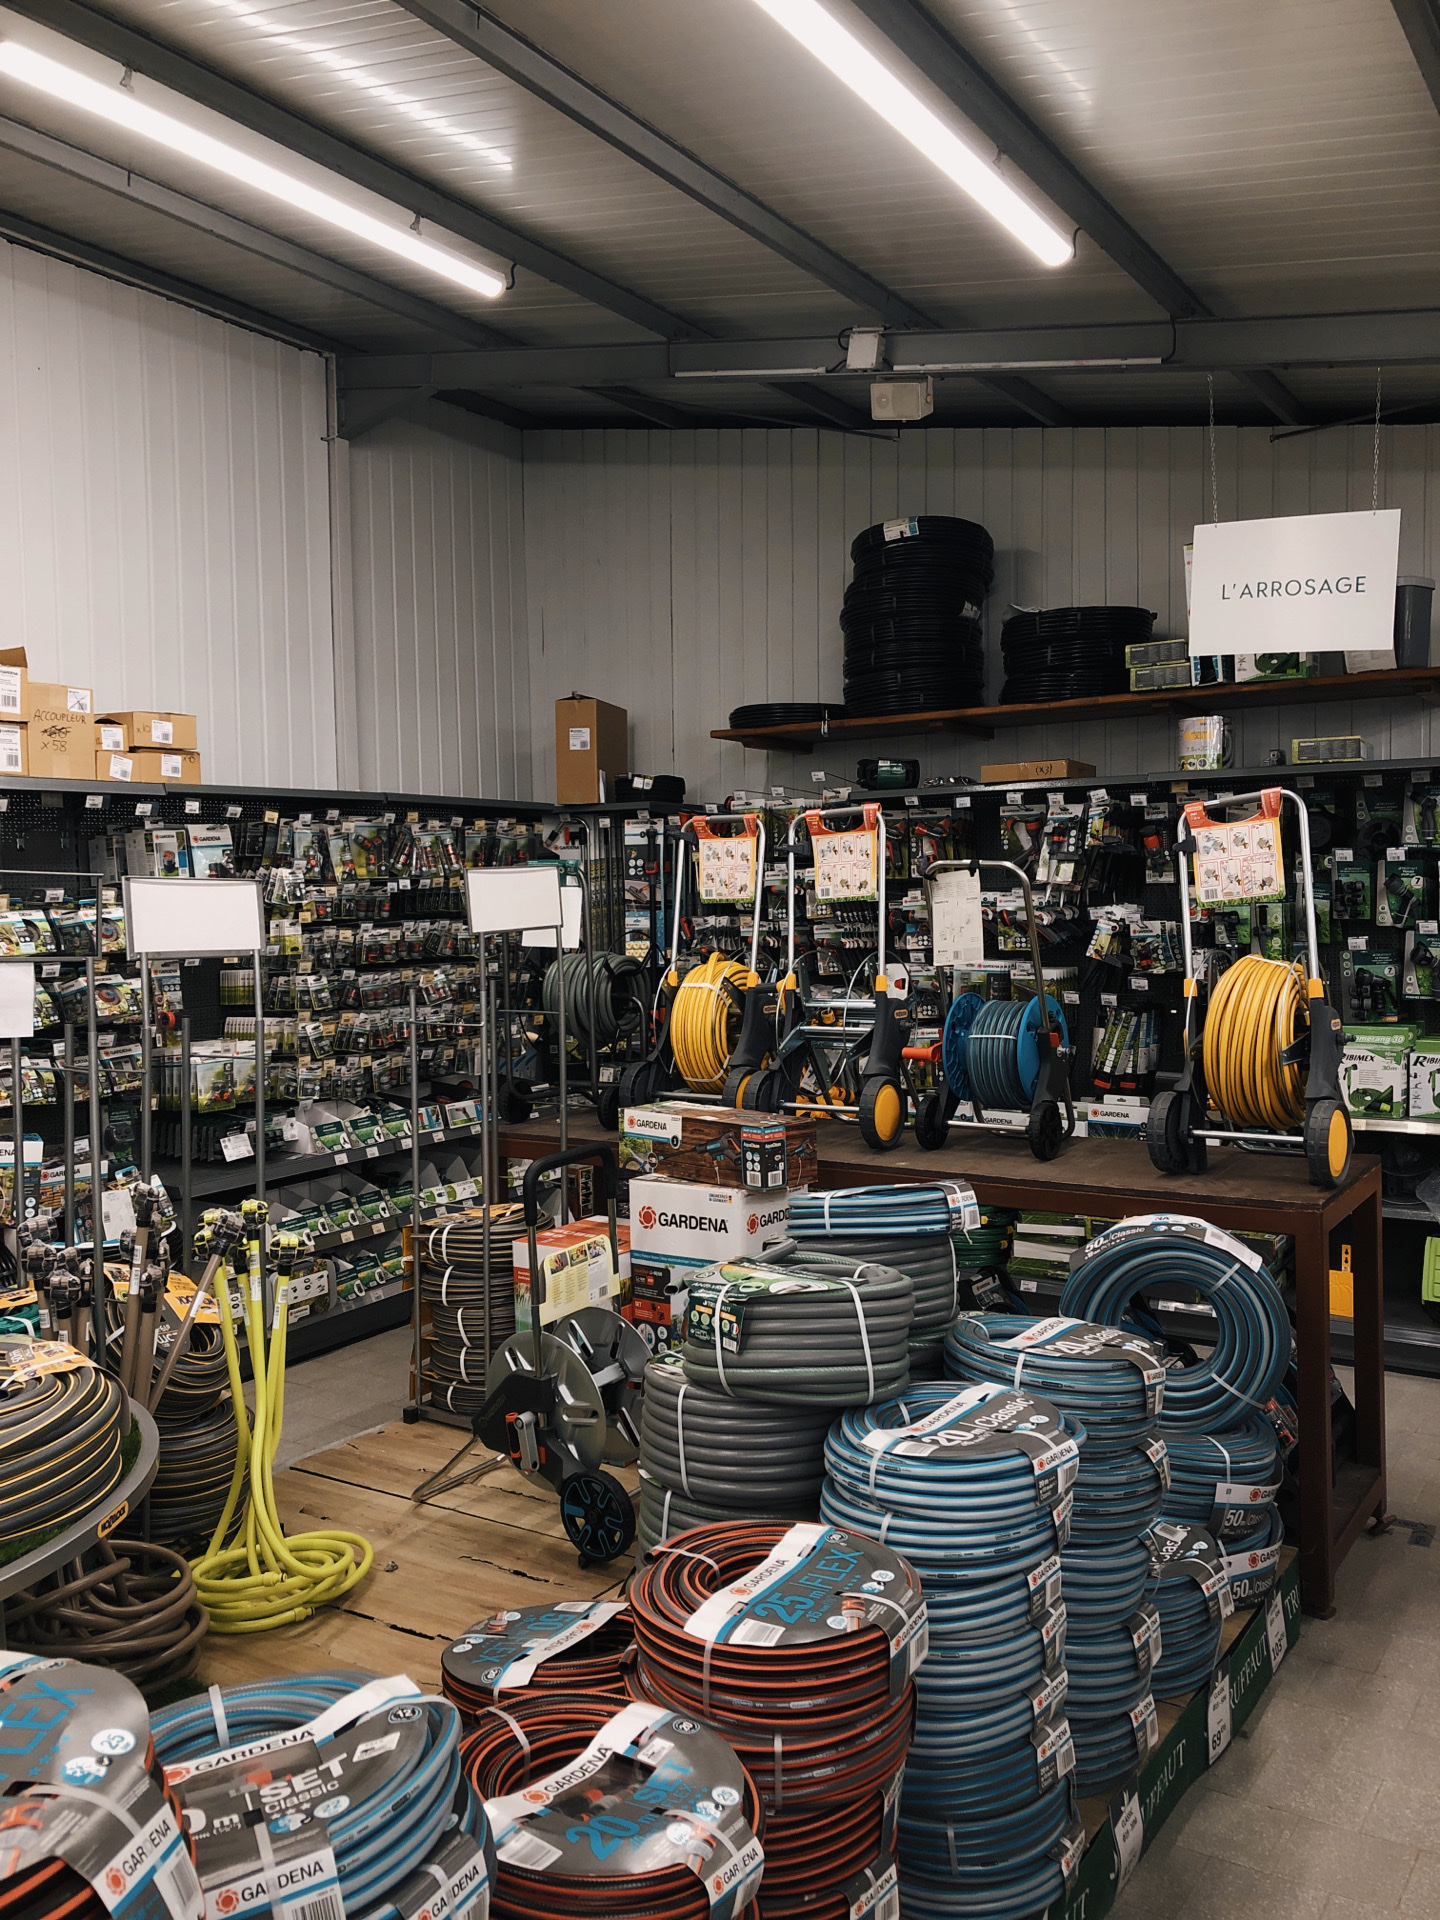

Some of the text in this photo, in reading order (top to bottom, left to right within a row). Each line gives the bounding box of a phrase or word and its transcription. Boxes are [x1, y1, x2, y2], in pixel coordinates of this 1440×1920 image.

[1221, 575, 1368, 601] L'ARROSAGE
[33, 709, 87, 725] ACCOUPLEUR
[1414, 877, 1421, 885] 7
[636, 1119, 668, 1131] GARDENA
[985, 1117, 1013, 1125] GARDENA
[1099, 1109, 1130, 1119] GARDENA
[658, 1211, 729, 1234] GARDENA
[1111, 1227, 1146, 1240] Classic
[1032, 1318, 1066, 1339] GARDENA
[921, 1400, 967, 1433] GARDENA
[974, 1397, 1035, 1427] Classic
[743, 1557, 790, 1591] GARDENA
[798, 1547, 865, 1592] FLEX
[1229, 1631, 1267, 1710] RUFFAUT
[101, 1732, 125, 1751] 25
[194, 1730, 314, 1773] GARDENA
[258, 1752, 349, 1804] SET
[545, 1743, 612, 1795] GARDENA
[632, 1757, 694, 1805] SET
[264, 1778, 341, 1815] Classic
[722, 1845, 759, 1884] GARENA
[240, 1860, 325, 1903] GADENA
[430, 1864, 480, 1919] GADENA
